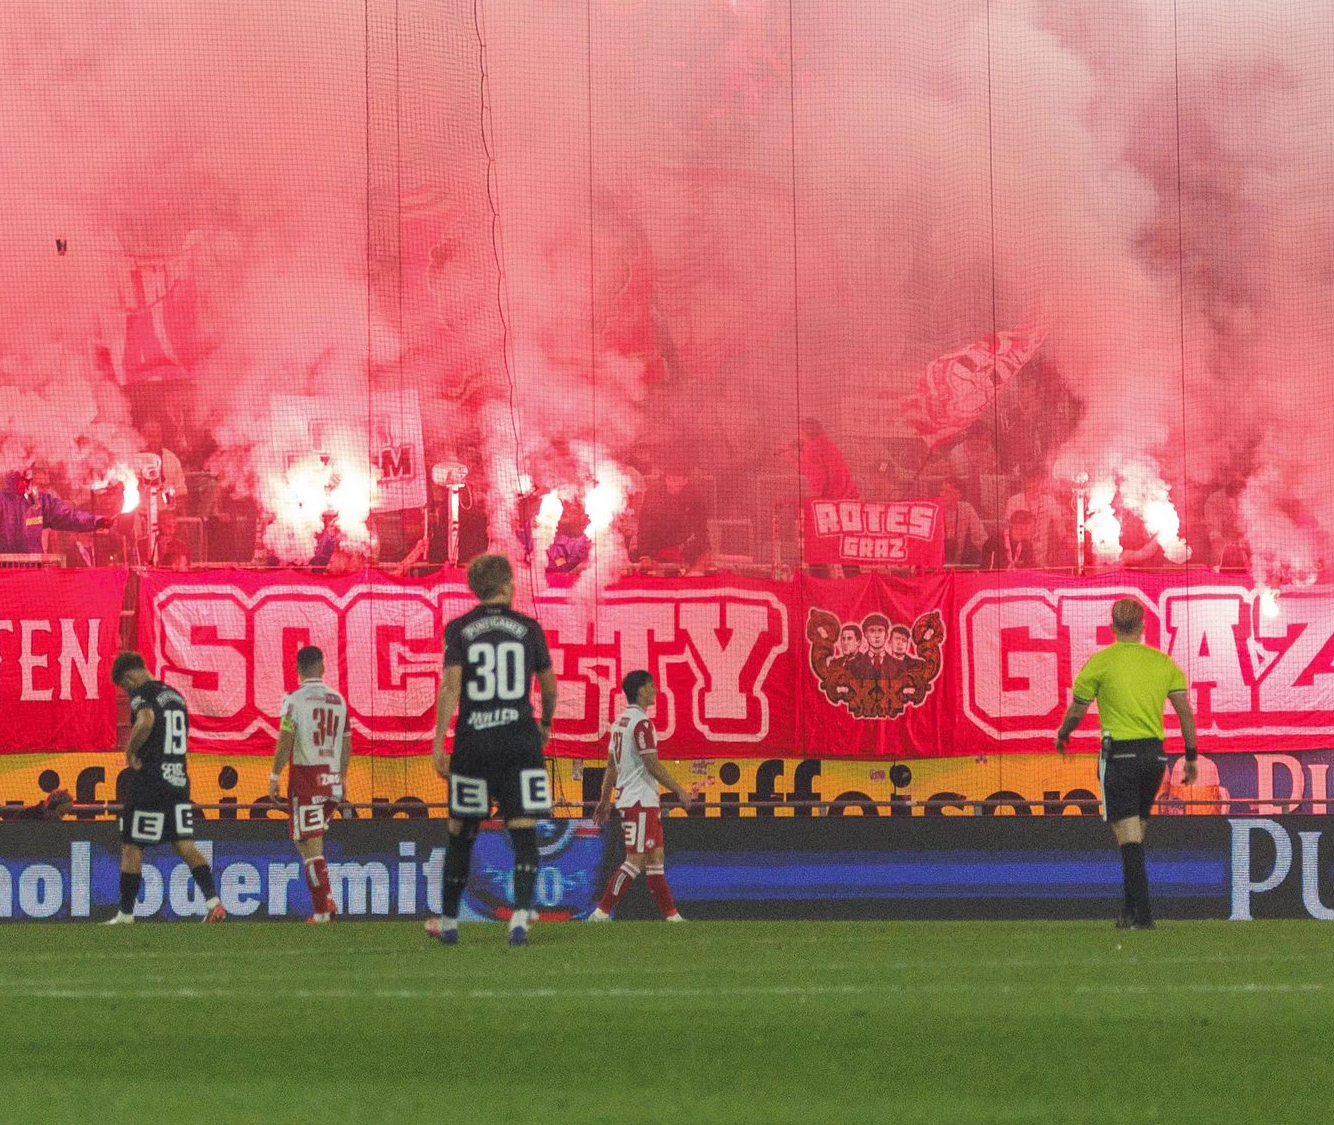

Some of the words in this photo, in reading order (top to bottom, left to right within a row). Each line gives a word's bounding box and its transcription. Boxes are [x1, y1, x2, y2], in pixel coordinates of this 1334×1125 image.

[813, 501, 935, 538] ROTES
[841, 536, 906, 559] GRAZ
[154, 583, 788, 742] SOCETY
[467, 641, 525, 701] 30
[163, 709, 187, 755] 19
[312, 707, 340, 747] 34
